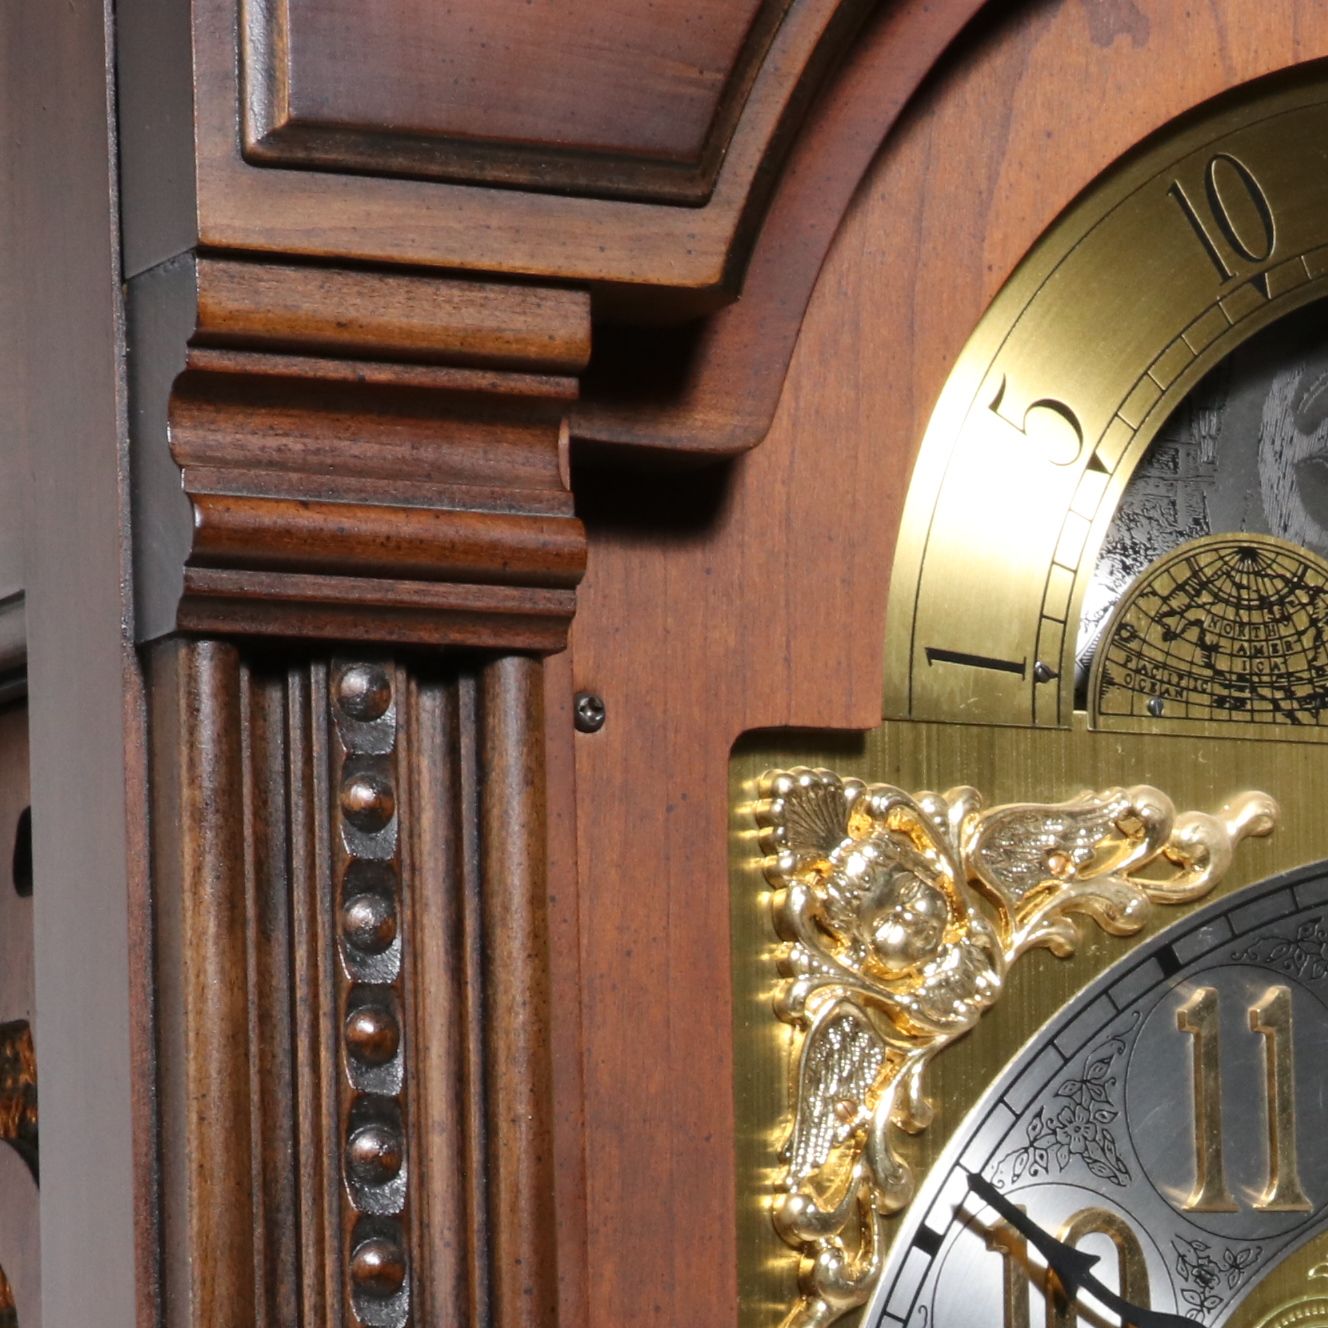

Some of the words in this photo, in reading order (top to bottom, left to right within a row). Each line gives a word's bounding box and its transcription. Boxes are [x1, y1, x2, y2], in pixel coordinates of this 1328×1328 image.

[1168, 152, 1277, 285] 10
[988, 373, 1084, 466] 5
[1209, 616, 1278, 639] NORTH
[924, 646, 1027, 681] 1
[1124, 654, 1210, 691] PACIFIC
[1123, 673, 1184, 698] OCEAN
[1176, 985, 1313, 1213] 11
